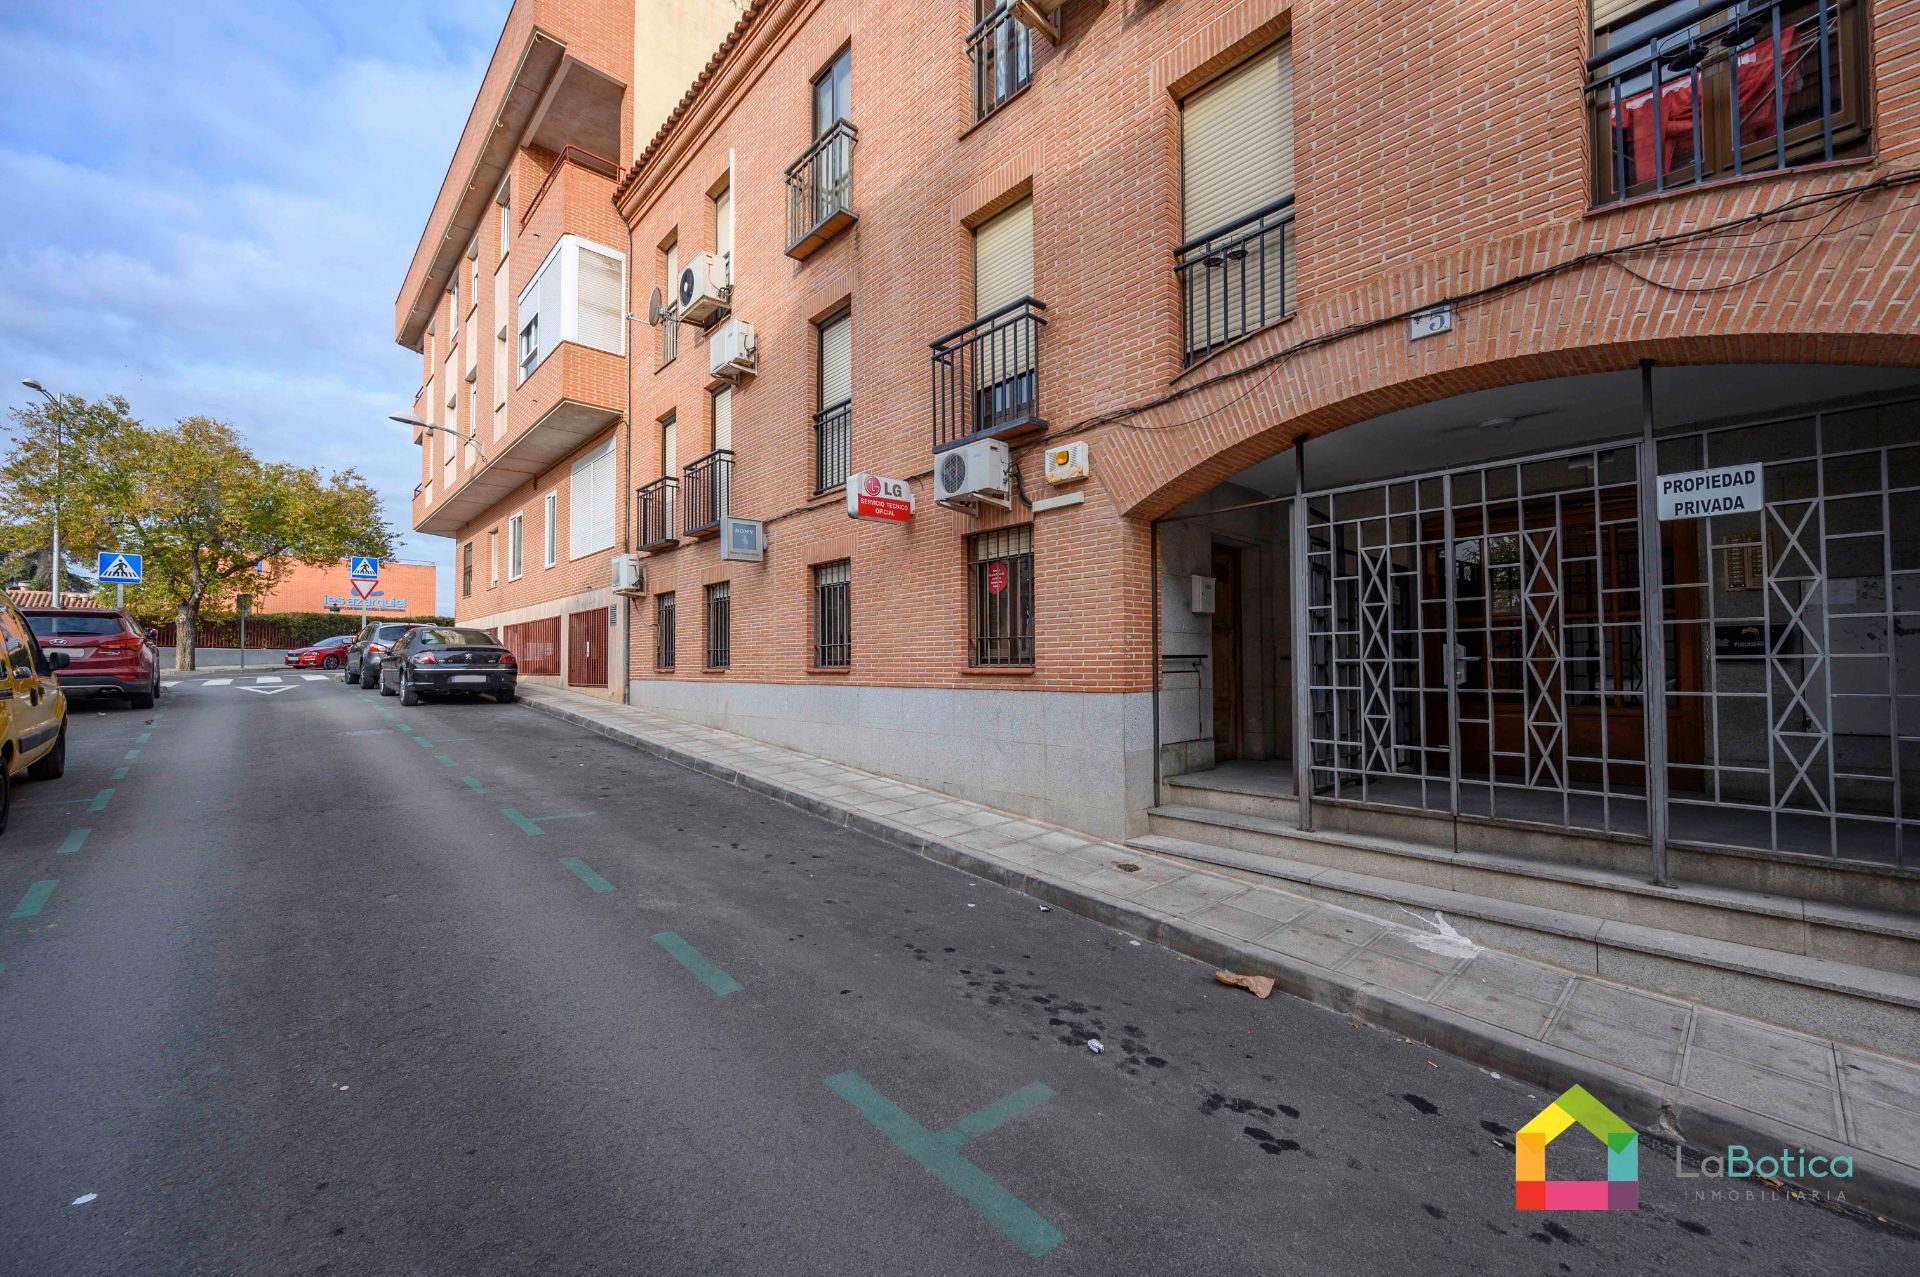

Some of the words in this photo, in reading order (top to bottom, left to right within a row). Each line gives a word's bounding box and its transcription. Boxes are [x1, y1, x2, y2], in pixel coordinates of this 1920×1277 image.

[1429, 306, 1446, 331] 5
[884, 482, 902, 498] LG
[1663, 470, 1756, 495] PROPIEDAD
[860, 497, 885, 508] SERVICIO
[1674, 495, 1745, 516] PRIVADA
[875, 508, 896, 517] OFICIAL
